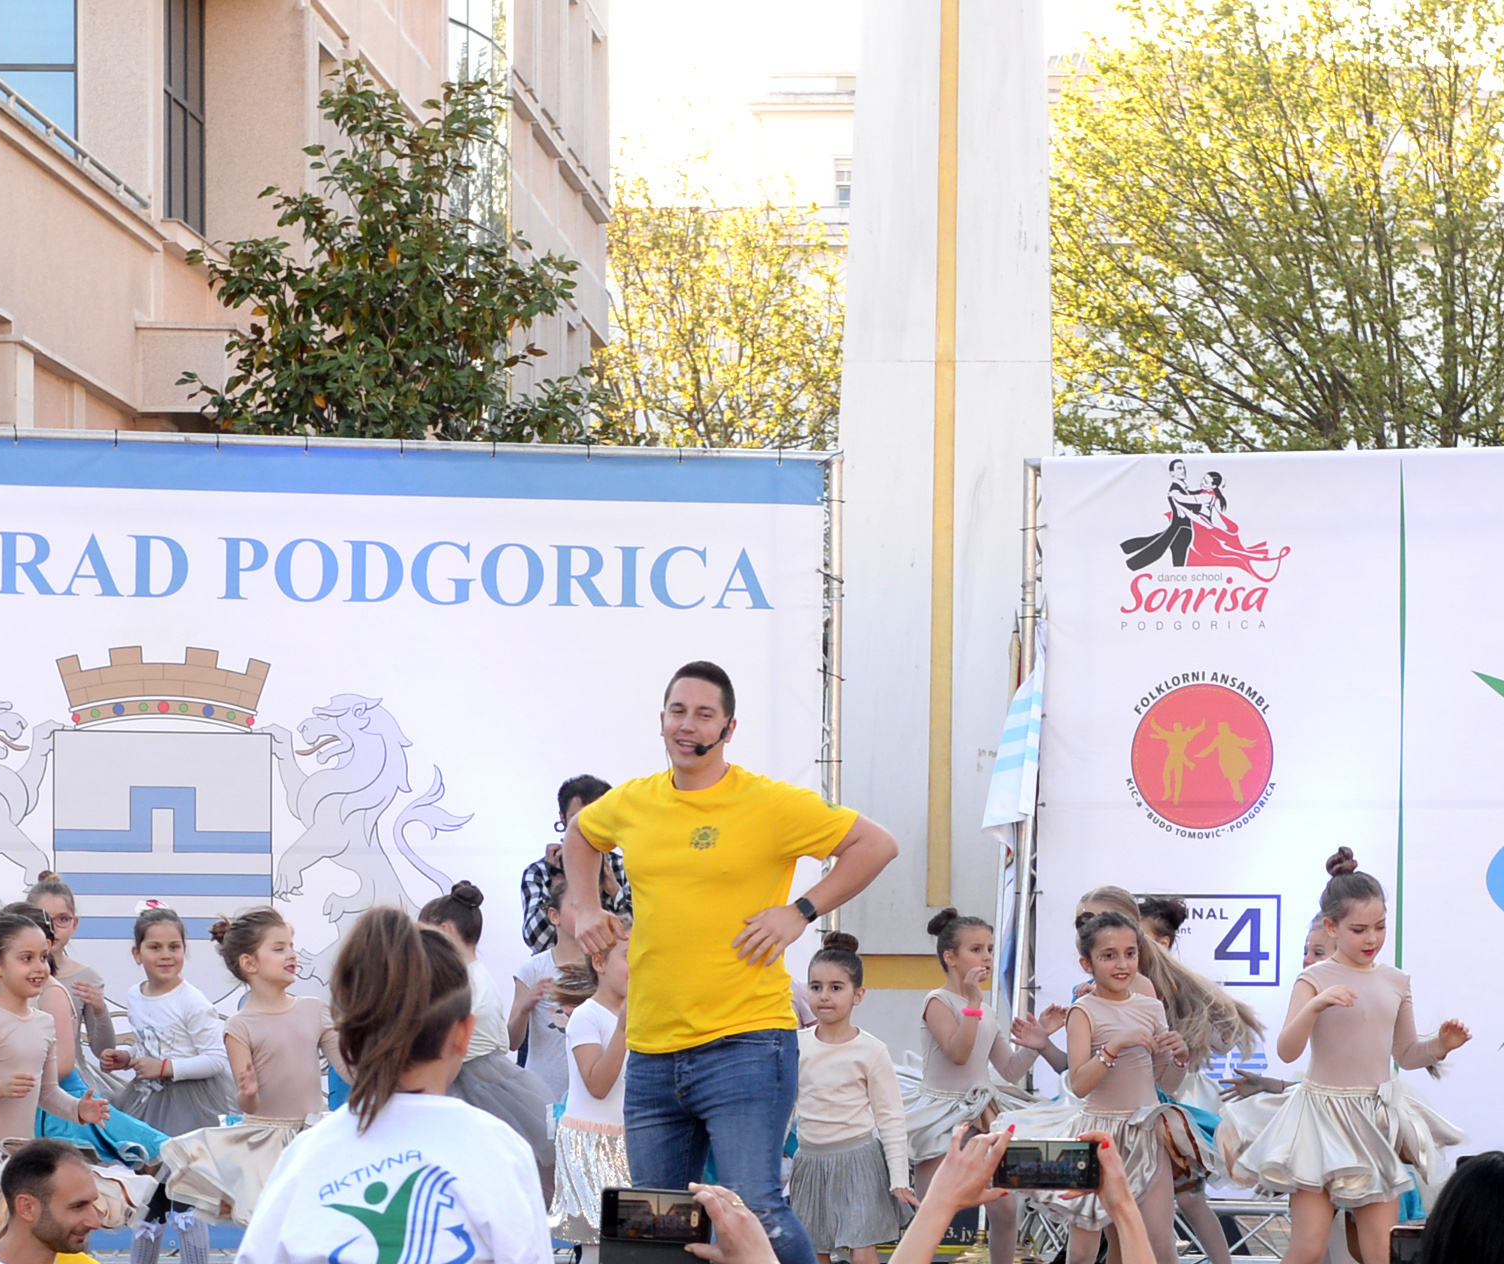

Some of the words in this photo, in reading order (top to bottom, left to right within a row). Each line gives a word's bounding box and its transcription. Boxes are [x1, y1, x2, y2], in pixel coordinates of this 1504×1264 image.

[218, 536, 774, 611] PODGORICA
[1120, 572, 1269, 615] Sonrisa
[1157, 572, 1188, 583] dance
[1190, 571, 1223, 583] school
[1120, 619, 1266, 631] PODGORICA
[1133, 671, 1206, 715] FOLKLORNI
[1210, 671, 1271, 715] ANSAMBL
[1214, 908, 1270, 976] 4
[318, 1149, 422, 1201] AKTIVNA
